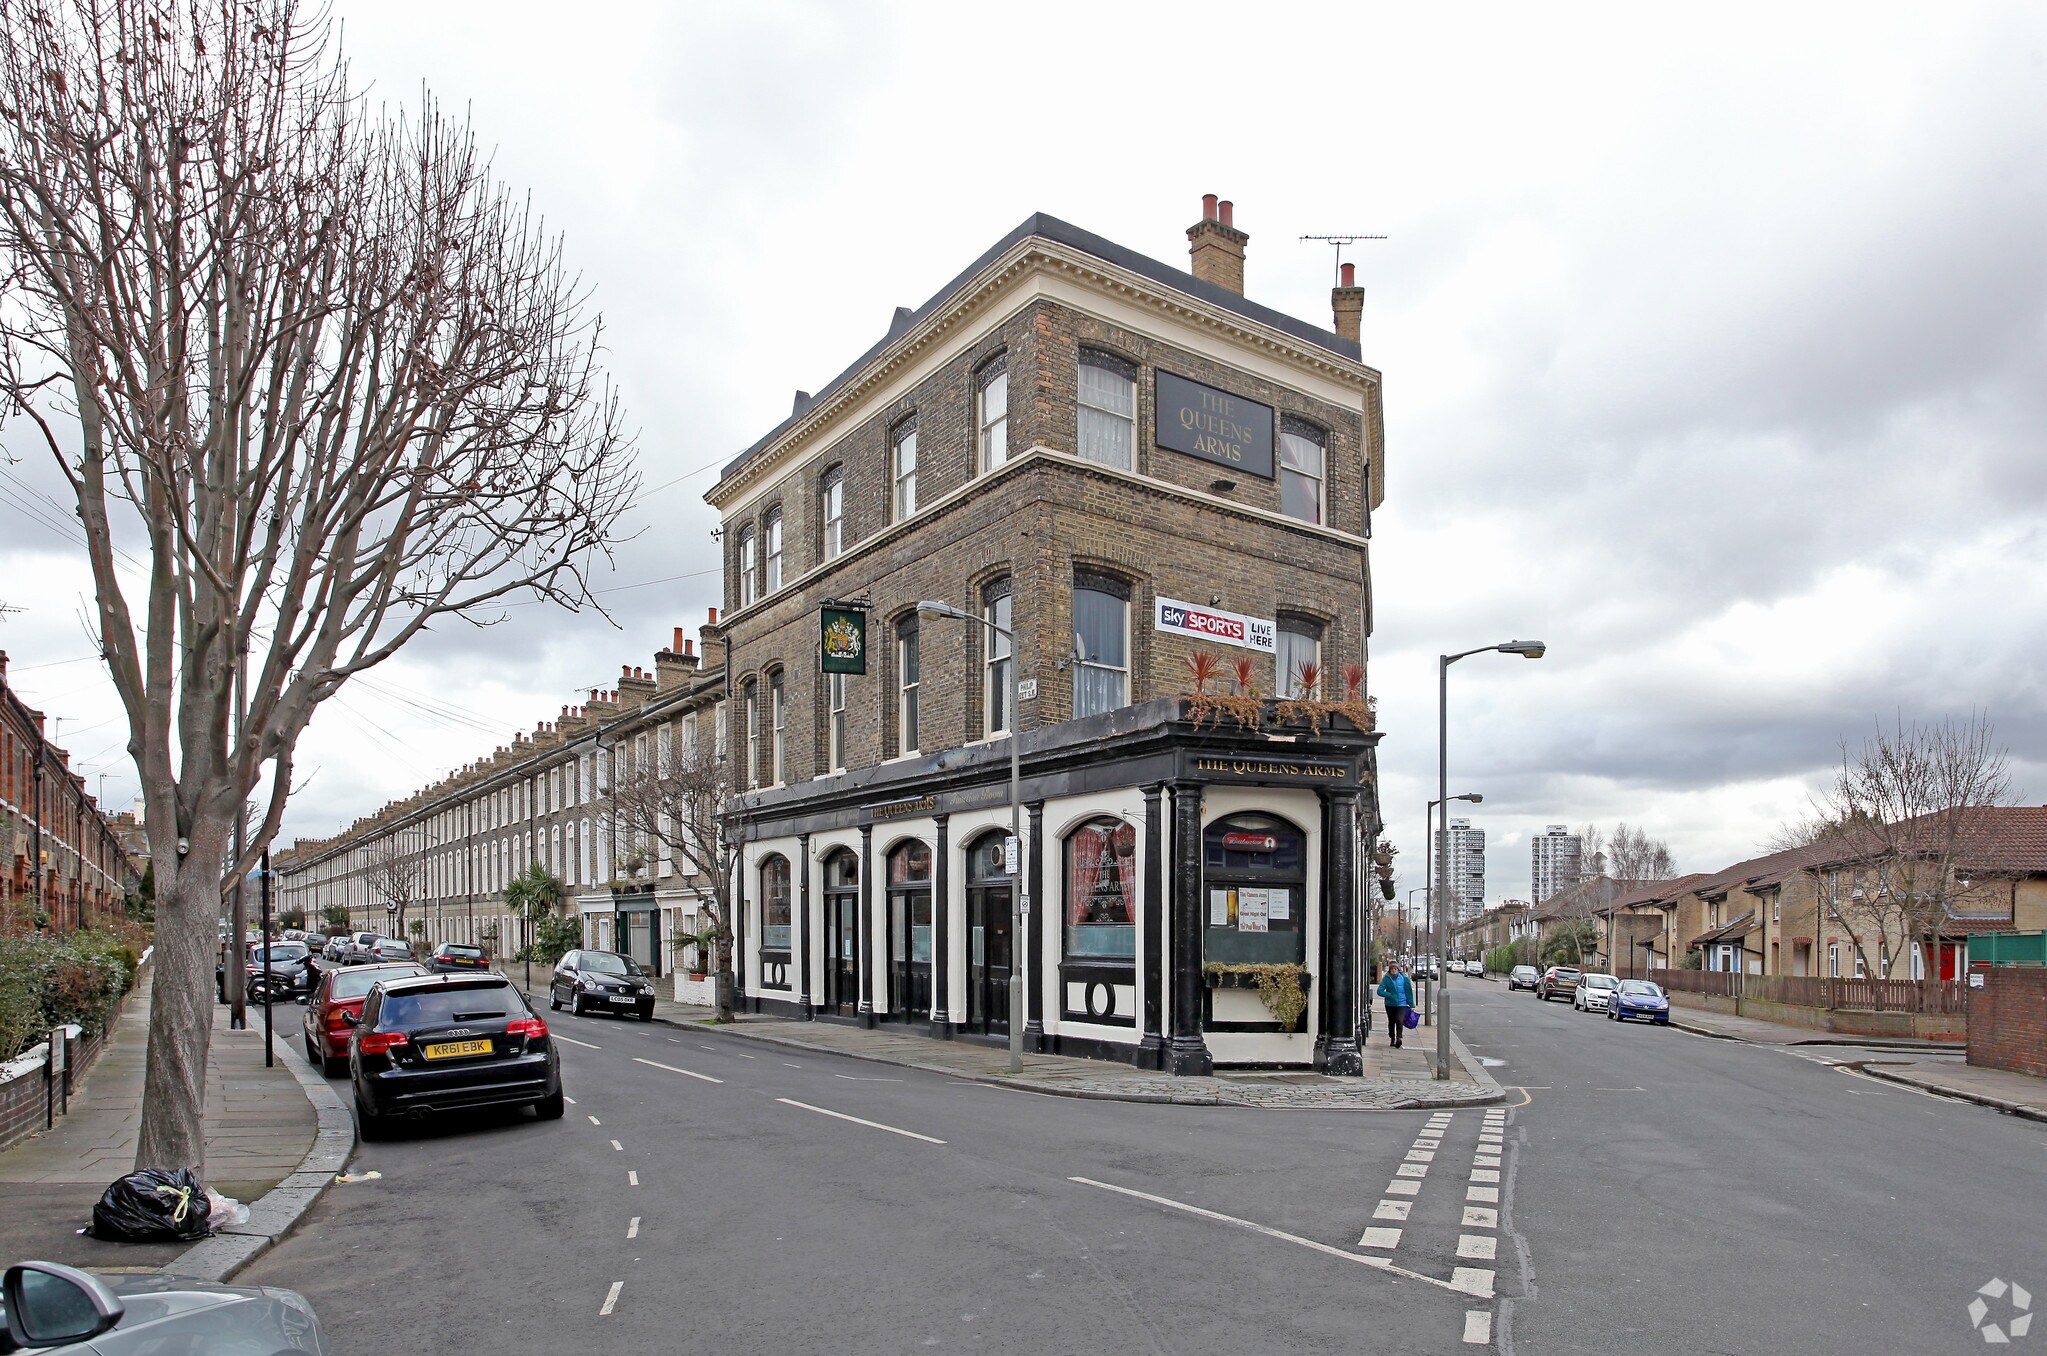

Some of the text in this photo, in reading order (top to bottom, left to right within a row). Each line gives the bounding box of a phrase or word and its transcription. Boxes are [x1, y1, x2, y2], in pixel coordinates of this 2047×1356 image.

[1198, 390, 1235, 418] THE
[1180, 407, 1252, 444] QUEENS
[1193, 433, 1241, 462] ARMS
[1163, 608, 1242, 637] sky SPORTS
[1251, 622, 1271, 636] LIVE
[1249, 634, 1273, 648] HERE
[1197, 759, 1346, 778] THE QUEENS ARMS
[870, 796, 936, 819] THE QUEENS ARMS
[1100, 870, 1110, 879] THE
[433, 1041, 485, 1056] KR61 EBK
